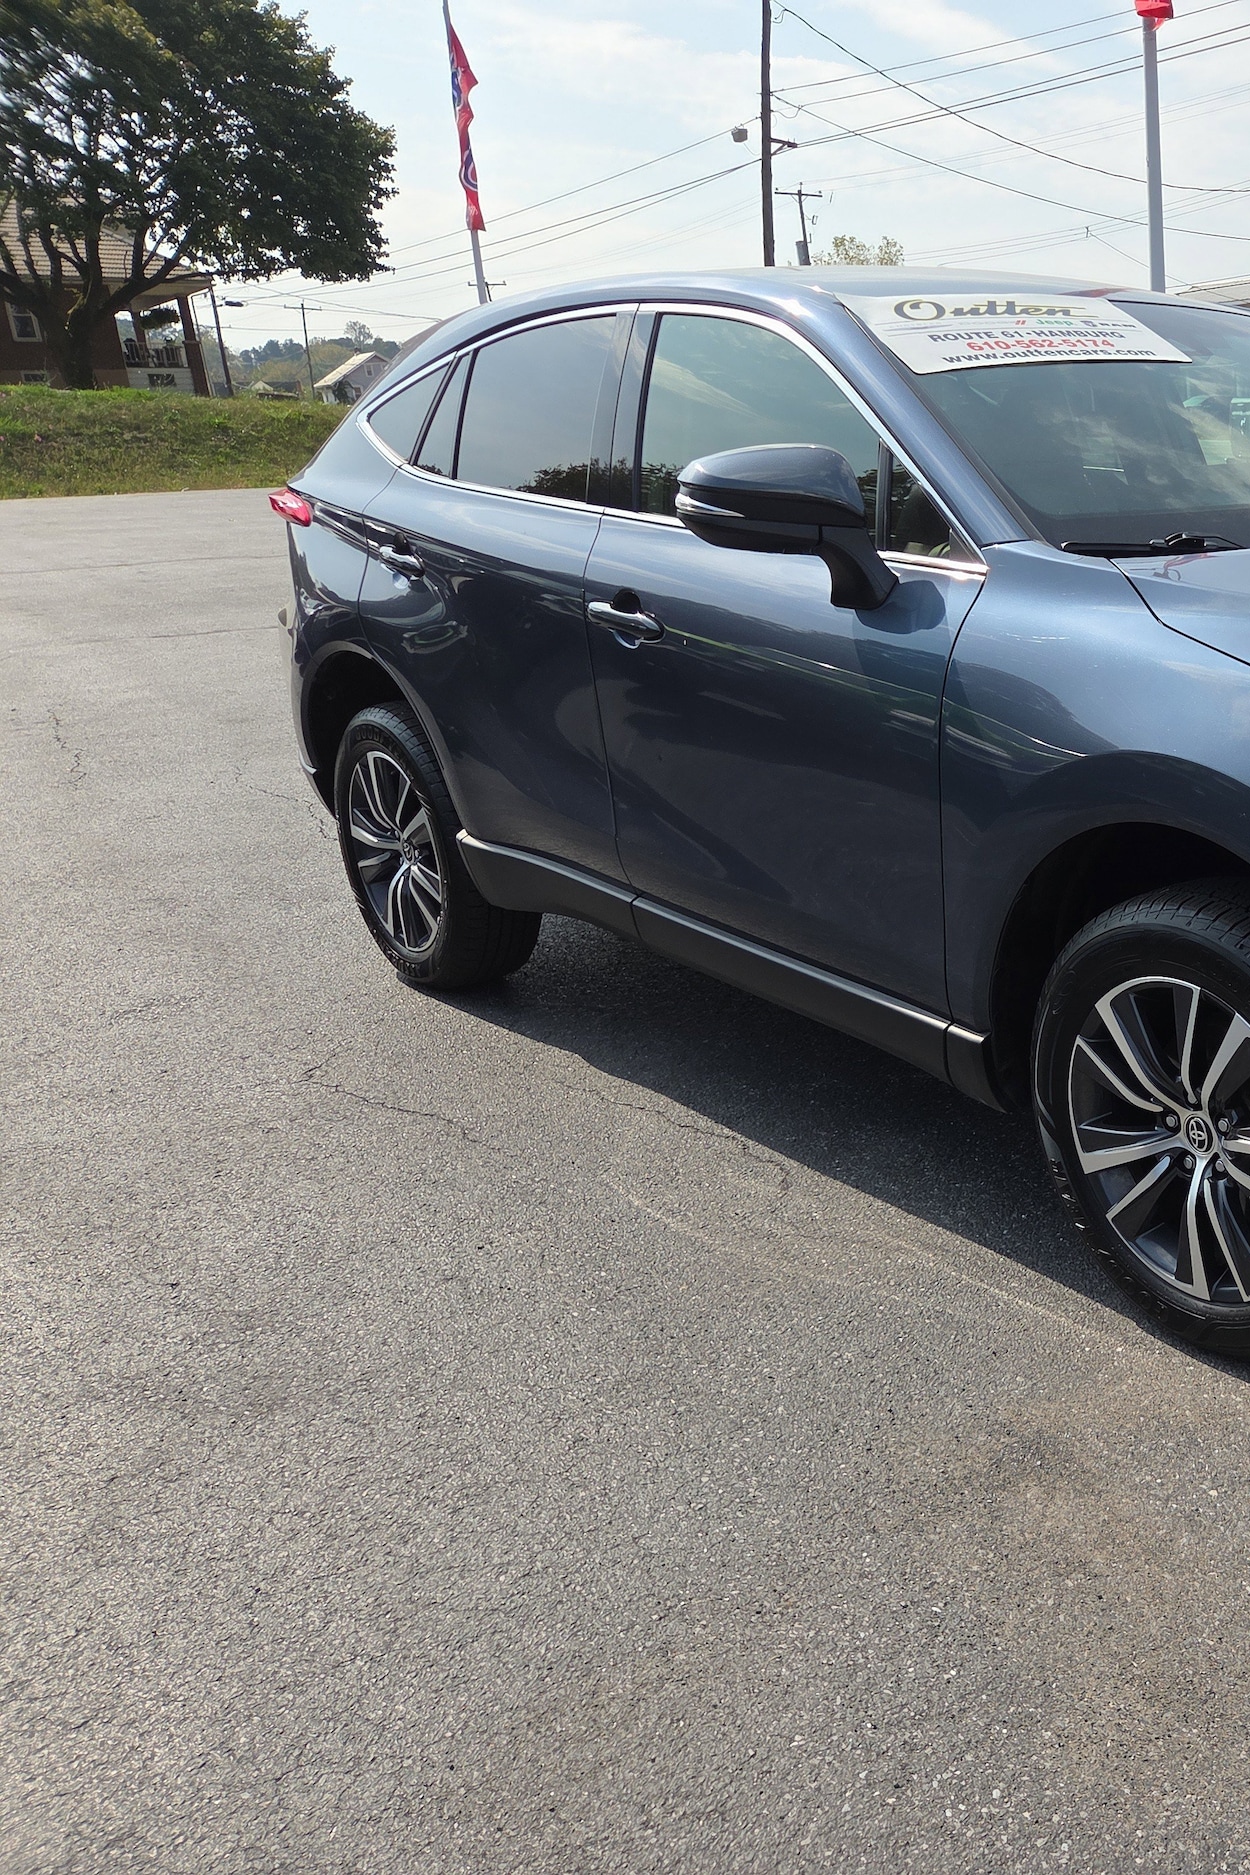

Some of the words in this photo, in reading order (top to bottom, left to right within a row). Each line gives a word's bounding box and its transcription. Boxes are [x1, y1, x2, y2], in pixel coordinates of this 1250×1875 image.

[894, 299, 1099, 321] Outten
[1036, 319, 1073, 327] Jeep
[928, 331, 999, 343] ROUTE
[966, 339, 1115, 352] 610-562-5174
[942, 348, 1157, 364] www.outtencars.com
